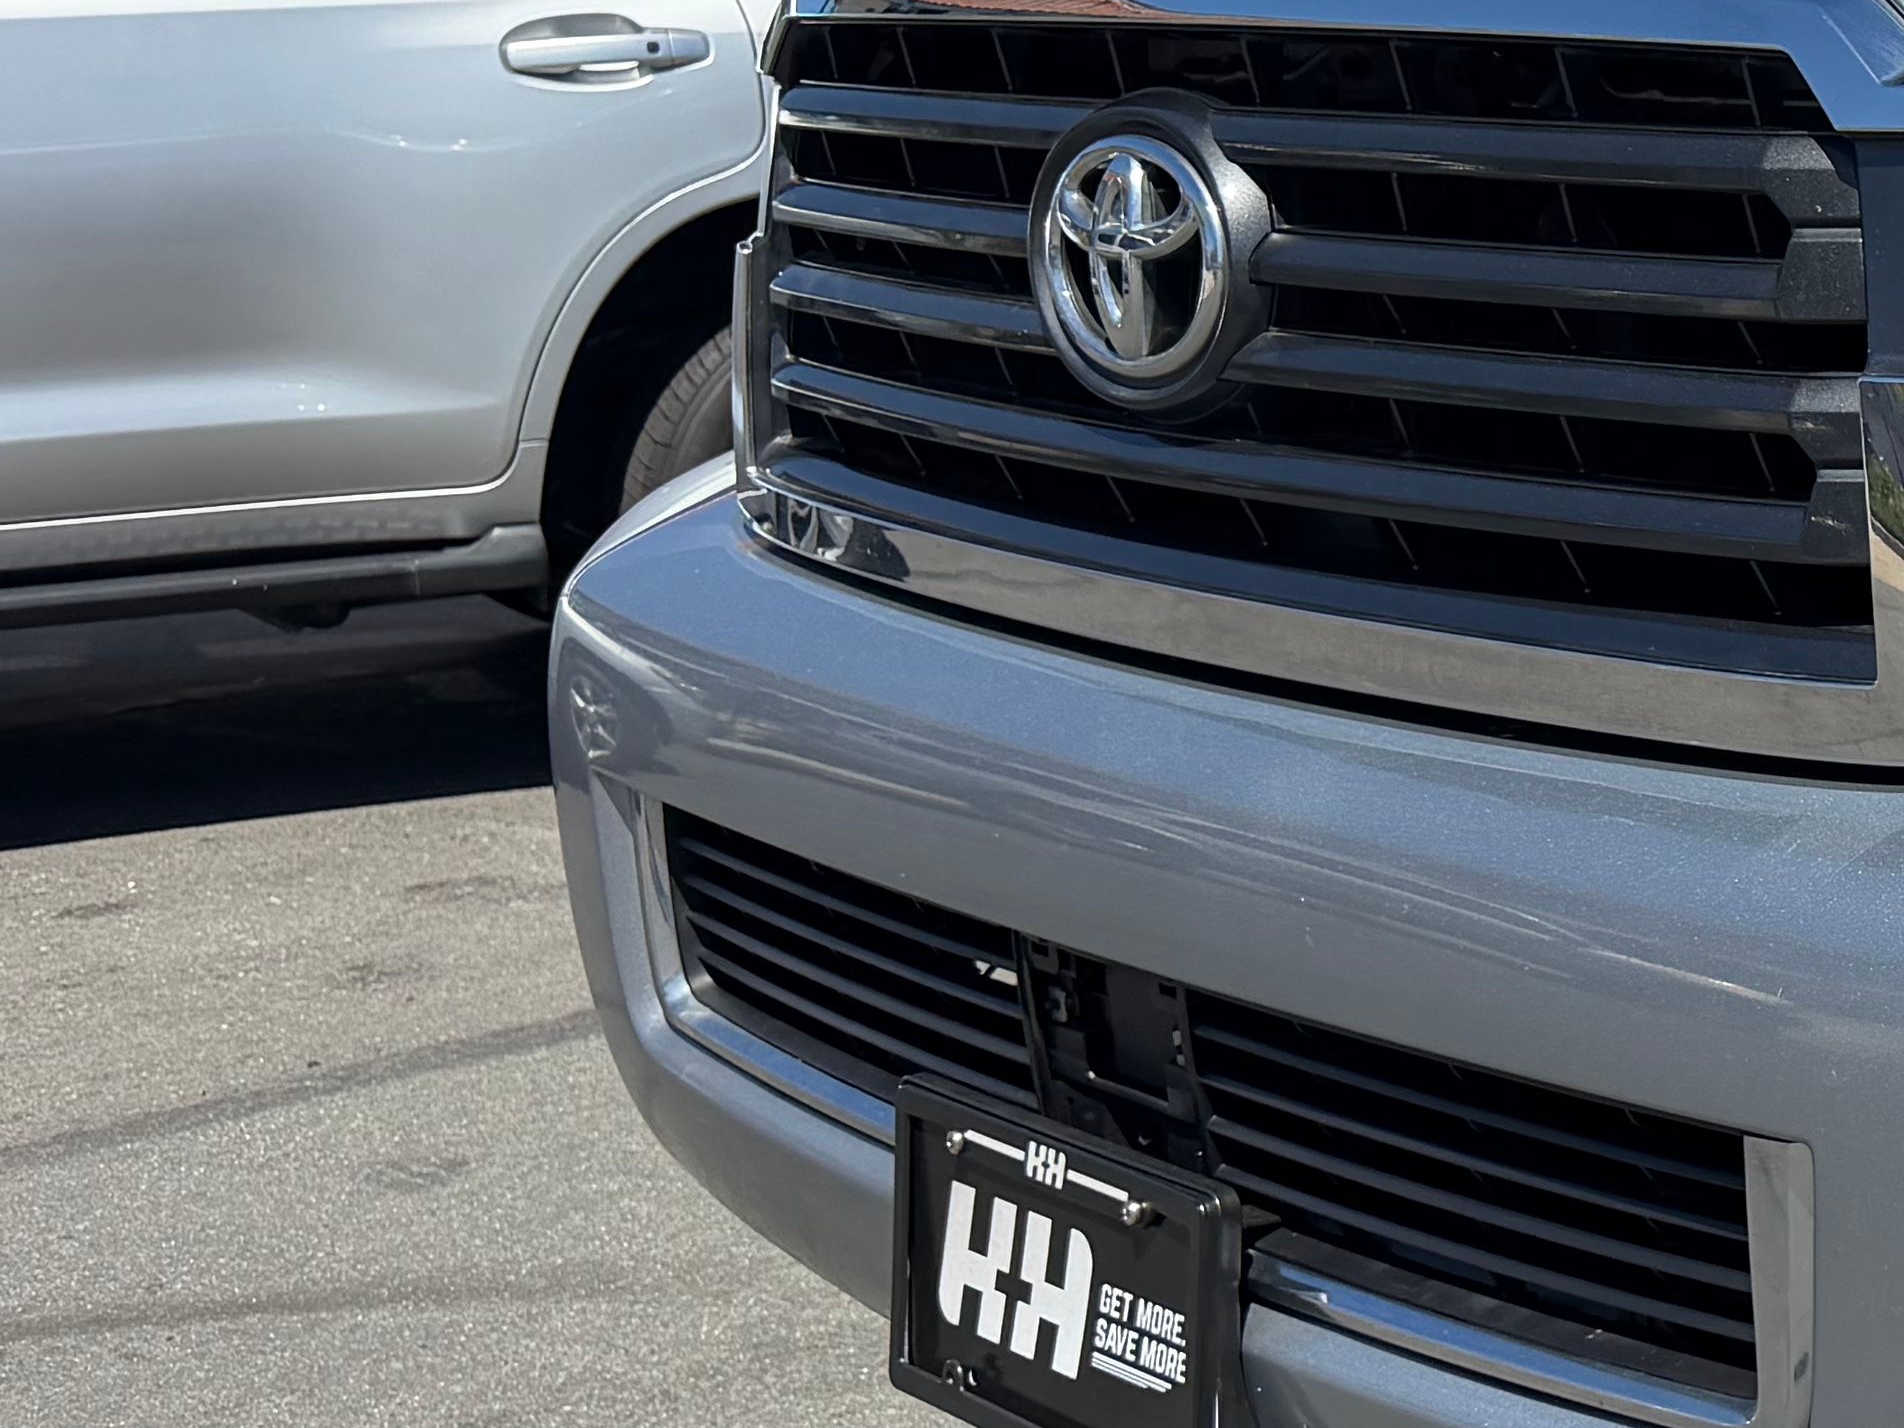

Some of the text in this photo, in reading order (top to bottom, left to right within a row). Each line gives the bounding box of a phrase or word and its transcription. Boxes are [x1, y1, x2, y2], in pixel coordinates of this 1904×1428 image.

[1099, 1283, 1187, 1347] GET MORE.
[1094, 1317, 1187, 1384] SAVE MORE
